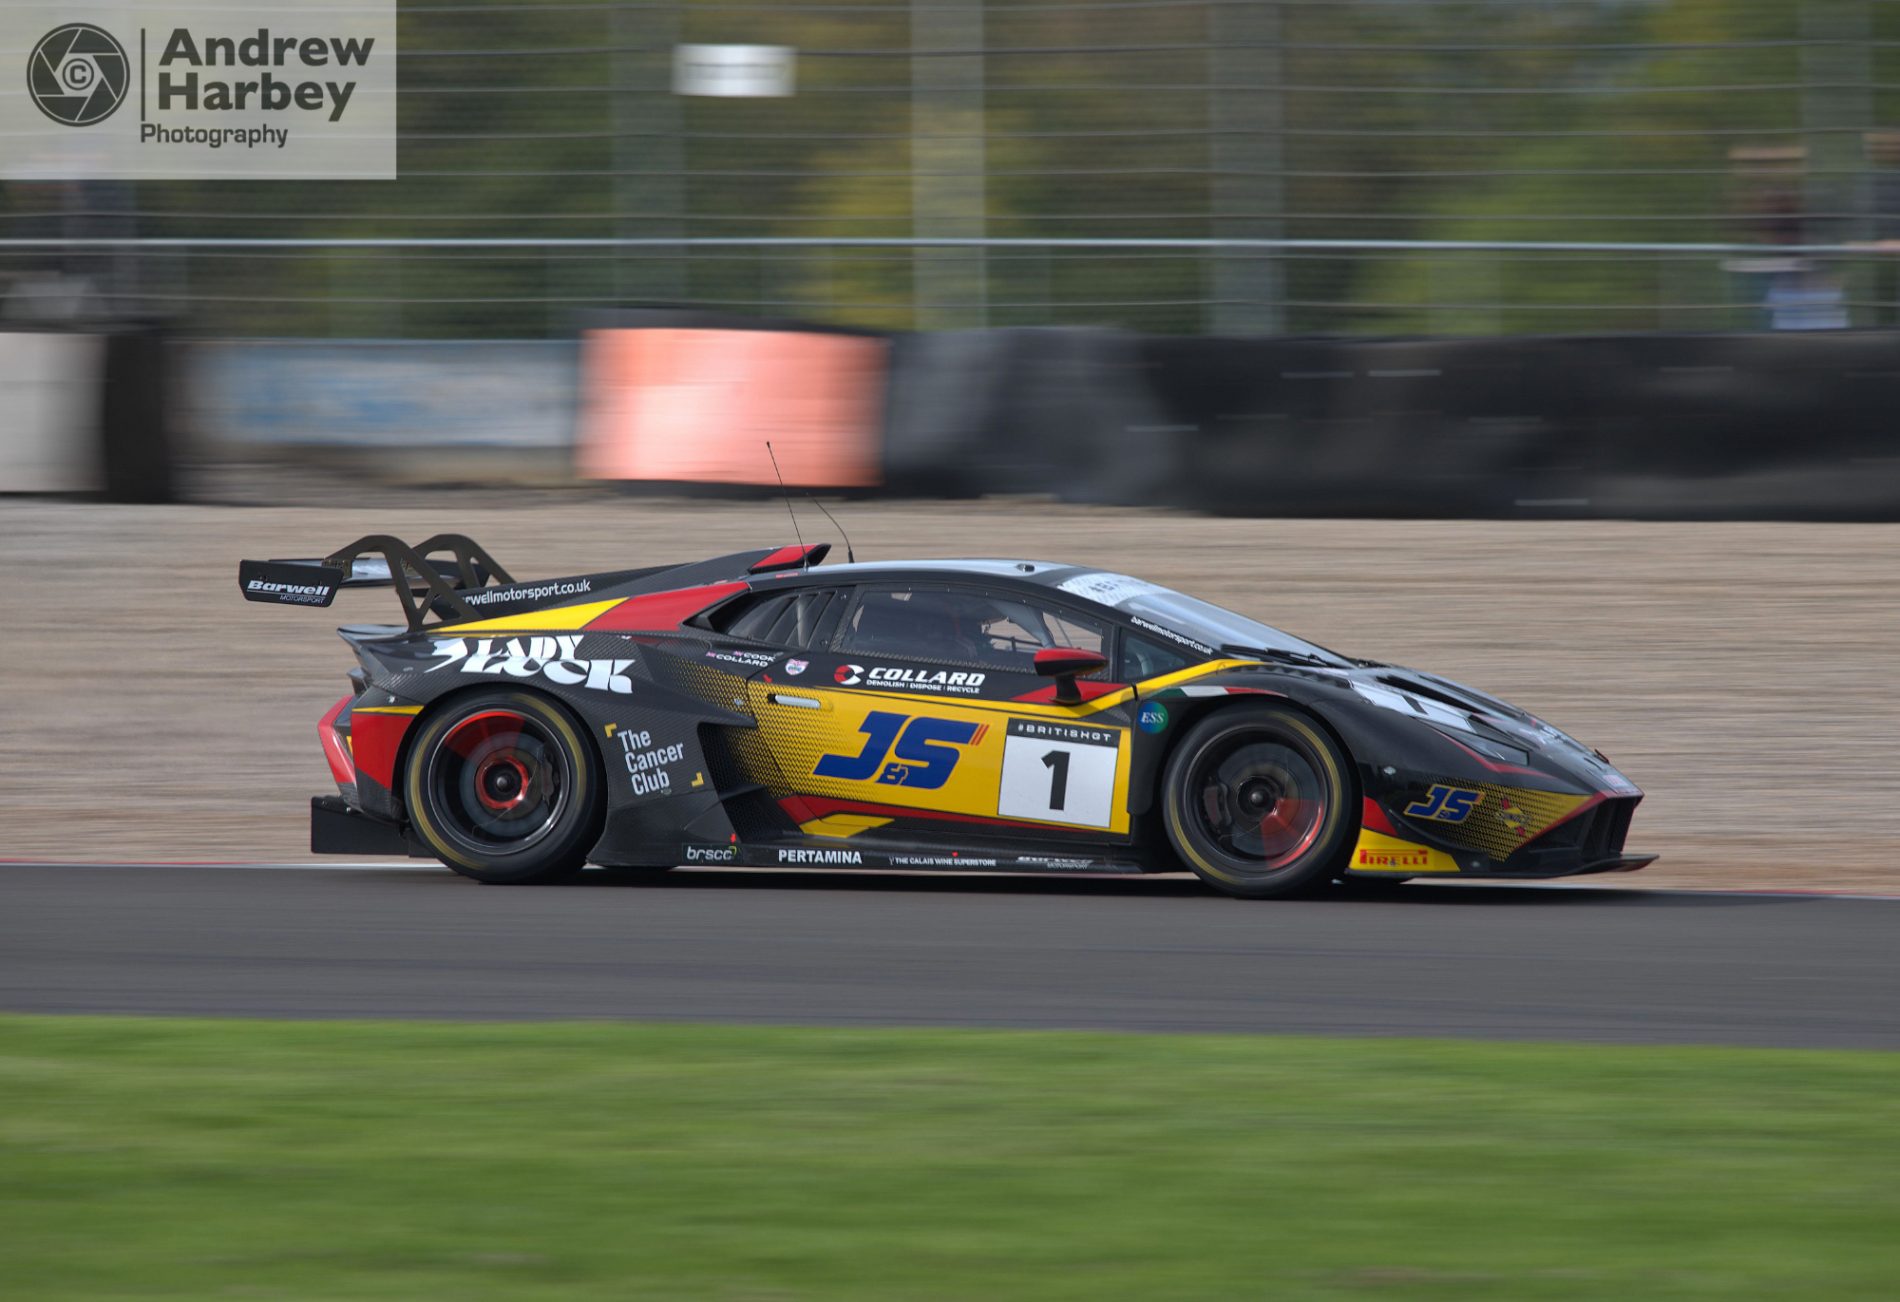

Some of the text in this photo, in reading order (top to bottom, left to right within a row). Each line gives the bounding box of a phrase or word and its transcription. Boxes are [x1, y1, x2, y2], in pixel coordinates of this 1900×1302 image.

[247, 580, 330, 596] Barwell
[476, 634, 584, 661] LADY
[716, 653, 769, 668] COLLARD
[743, 652, 775, 662] COOK
[460, 652, 636, 694] LUCK
[868, 667, 986, 687] COLLARD
[866, 679, 980, 694] DEMOLISH DISPOSE RECYCLE
[1141, 711, 1165, 724] ESS
[617, 729, 652, 752] The
[625, 742, 684, 774] Cancer
[631, 767, 671, 796] Club
[1041, 750, 1071, 811] 1
[686, 845, 733, 861] brscc
[778, 849, 863, 865] PERTAMINA
[1360, 849, 1428, 865] PIRELLI
[895, 857, 997, 867] THE CALAIS WINE SUPERSTORE
